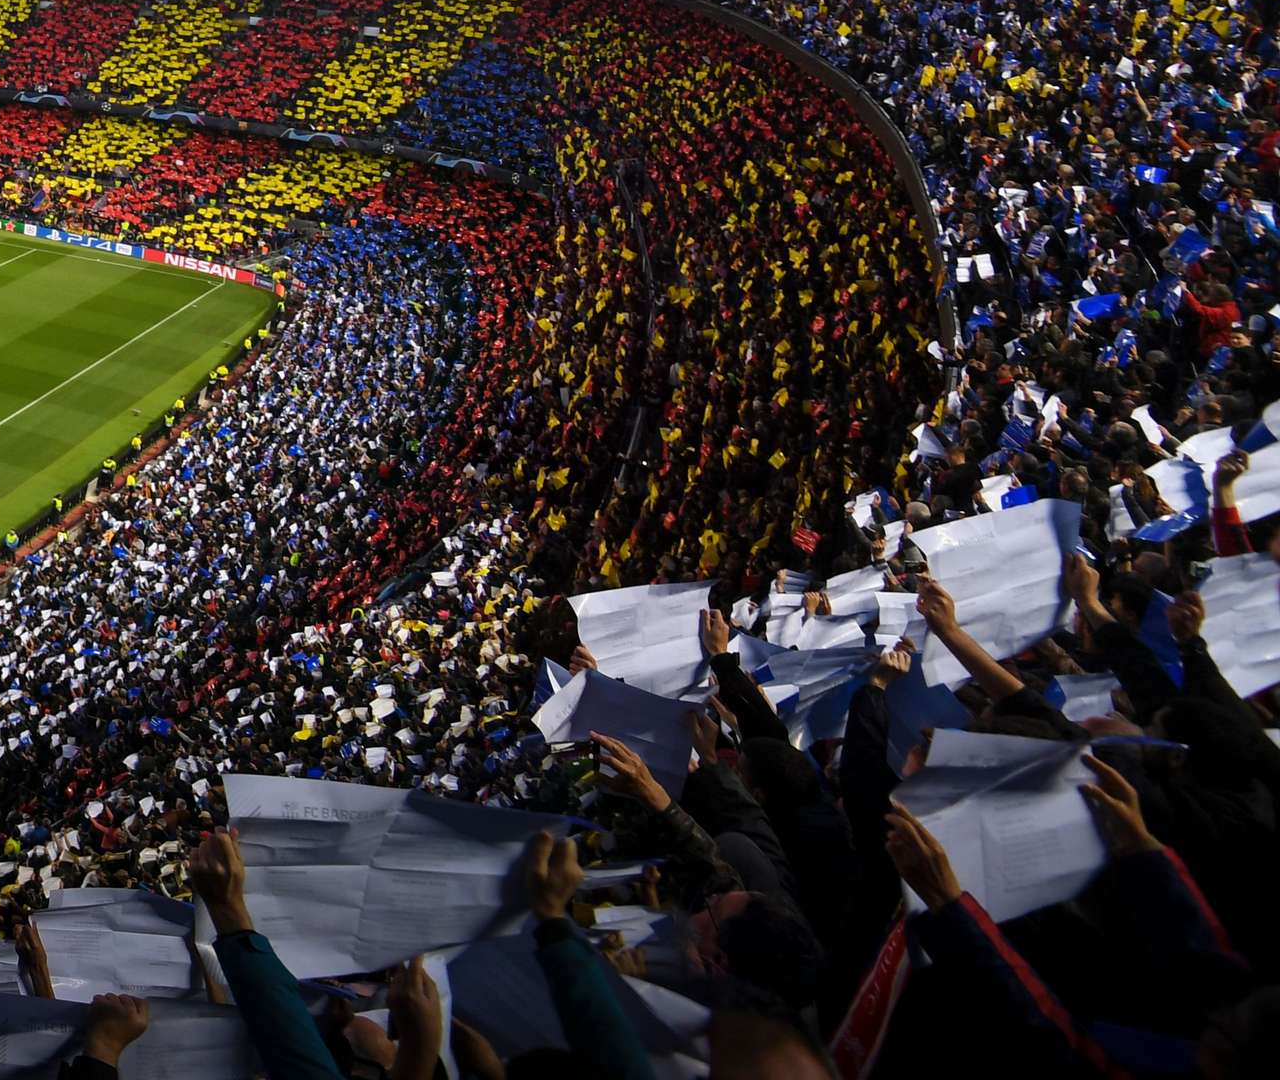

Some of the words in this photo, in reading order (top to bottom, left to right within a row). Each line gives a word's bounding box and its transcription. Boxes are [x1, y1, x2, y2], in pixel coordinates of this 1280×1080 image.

[67, 233, 113, 252] PS4
[164, 252, 237, 280] NISSAN
[303, 806, 319, 819] FC
